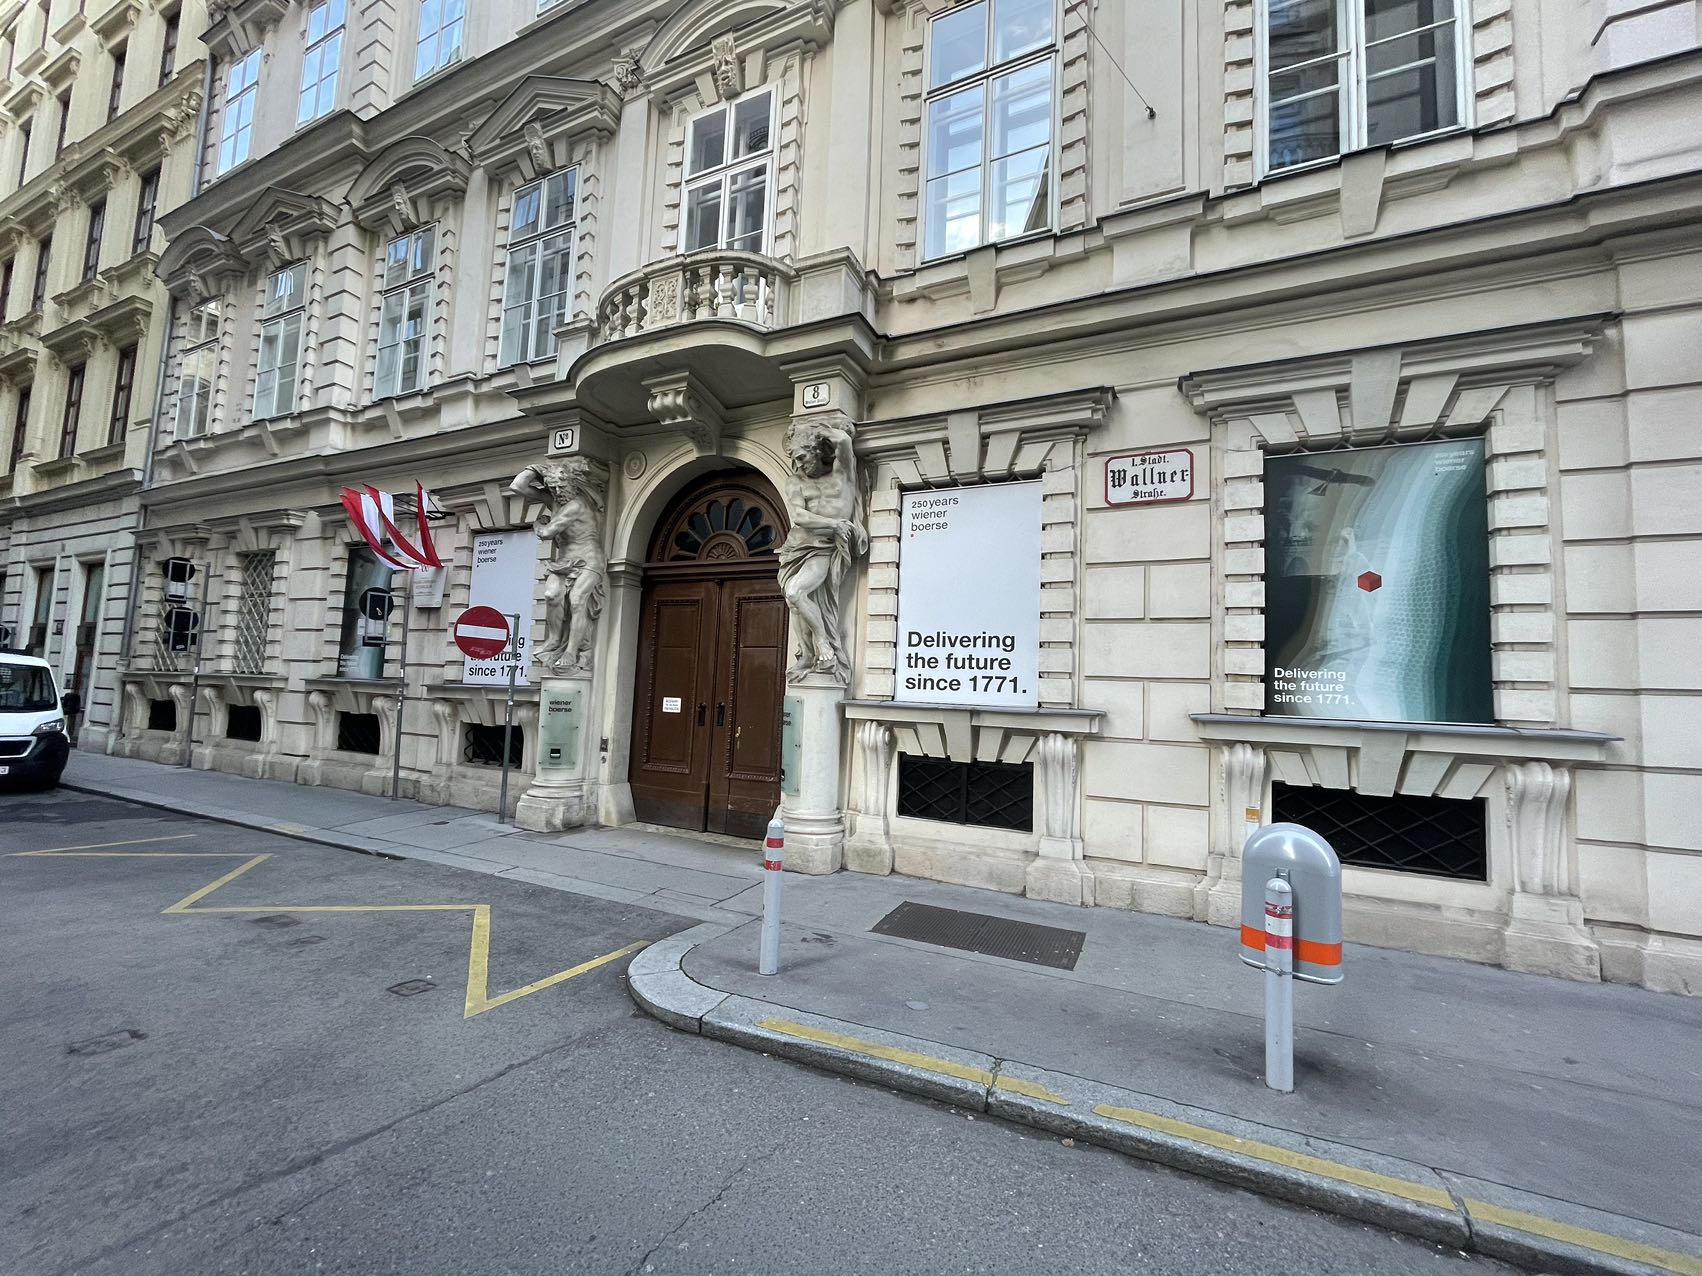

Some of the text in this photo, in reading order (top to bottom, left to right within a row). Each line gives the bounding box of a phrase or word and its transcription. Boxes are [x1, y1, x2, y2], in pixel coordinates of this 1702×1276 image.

[812, 385, 820, 399] 8
[1139, 455, 1169, 466] Stadt.
[911, 509, 948, 520] wiener
[911, 521, 949, 532] boerse
[477, 548, 497, 556] wiener
[477, 556, 497, 564] boerse
[907, 631, 1016, 653] Delivering
[905, 652, 1012, 671] the future
[468, 664, 497, 677] since
[1274, 667, 1346, 682] Delivering
[905, 673, 1028, 694] since 1771.
[1274, 680, 1345, 692] the future
[1274, 692, 1356, 705] since 1771.
